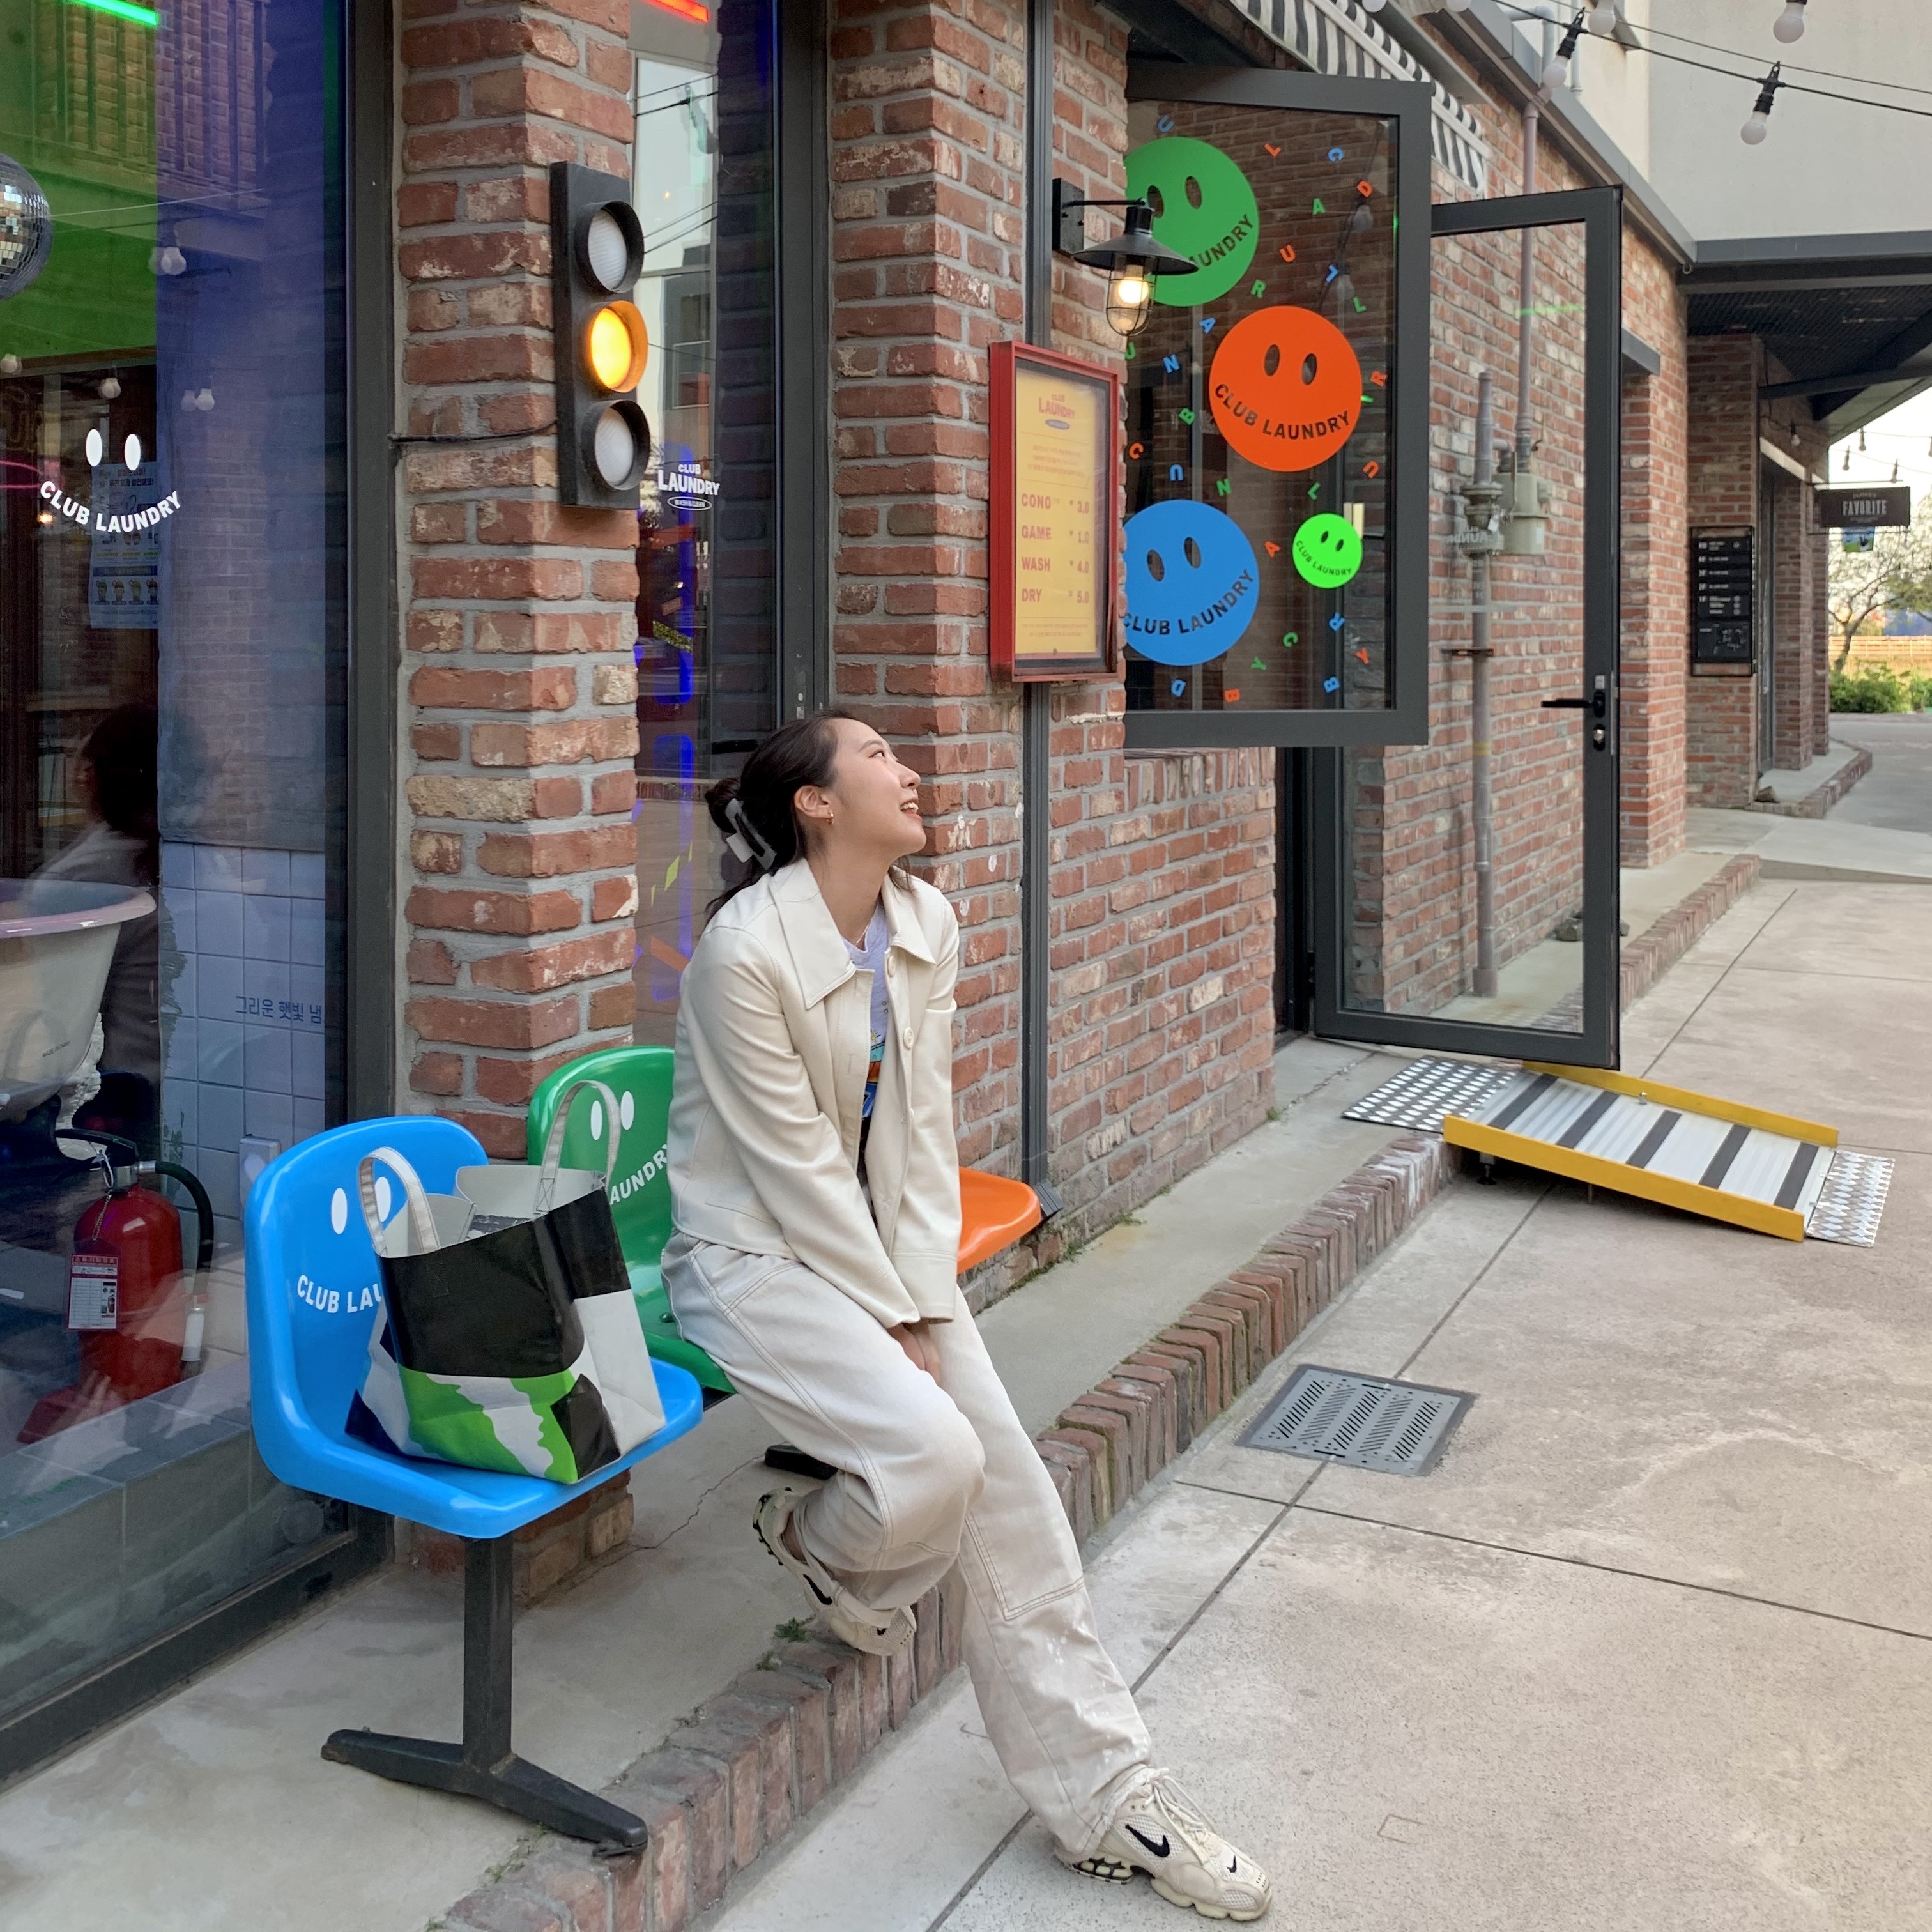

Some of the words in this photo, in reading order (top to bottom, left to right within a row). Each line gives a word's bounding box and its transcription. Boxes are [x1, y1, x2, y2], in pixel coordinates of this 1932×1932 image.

[1158, 115, 1174, 133] U
[1312, 198, 1326, 215] A
[1280, 244, 1296, 263] U
[1250, 280, 1266, 298] R
[1199, 317, 1216, 334] A
[1163, 354, 1180, 373] N
[1370, 371, 1387, 386] R
[1038, 397, 1075, 420] LAUNDRY
[1179, 409, 1195, 424] B
[1215, 384, 1258, 426] CLUB
[1262, 410, 1349, 440] LAUNDRY
[678, 464, 702, 475] CLUB
[1169, 464, 1184, 481] U
[1363, 461, 1379, 478] U
[657, 469, 721, 496] LAUNDRY
[1216, 478, 1232, 496] N
[40, 480, 90, 525] CLUB
[96, 490, 181, 533] LAUNDRY
[1842, 499, 1887, 516] FAVORITE
[1022, 525, 1052, 540] GAME
[1265, 542, 1280, 557] A
[1296, 540, 1312, 563] CLUB
[1312, 561, 1352, 576] LAUNDRY
[1022, 556, 1051, 572] WASH
[1022, 588, 1043, 602] DRY
[1124, 613, 1170, 635] CLUB
[1178, 568, 1254, 634] LAUNDRY
[1329, 613, 1344, 631] R
[1323, 677, 1339, 693] B
[1224, 689, 1240, 703] B
[235, 995, 274, 1018] 그리운
[279, 1000, 304, 1022] 햇빛
[609, 1144, 668, 1206] AUNDR
[297, 1274, 340, 1314] CLUB
